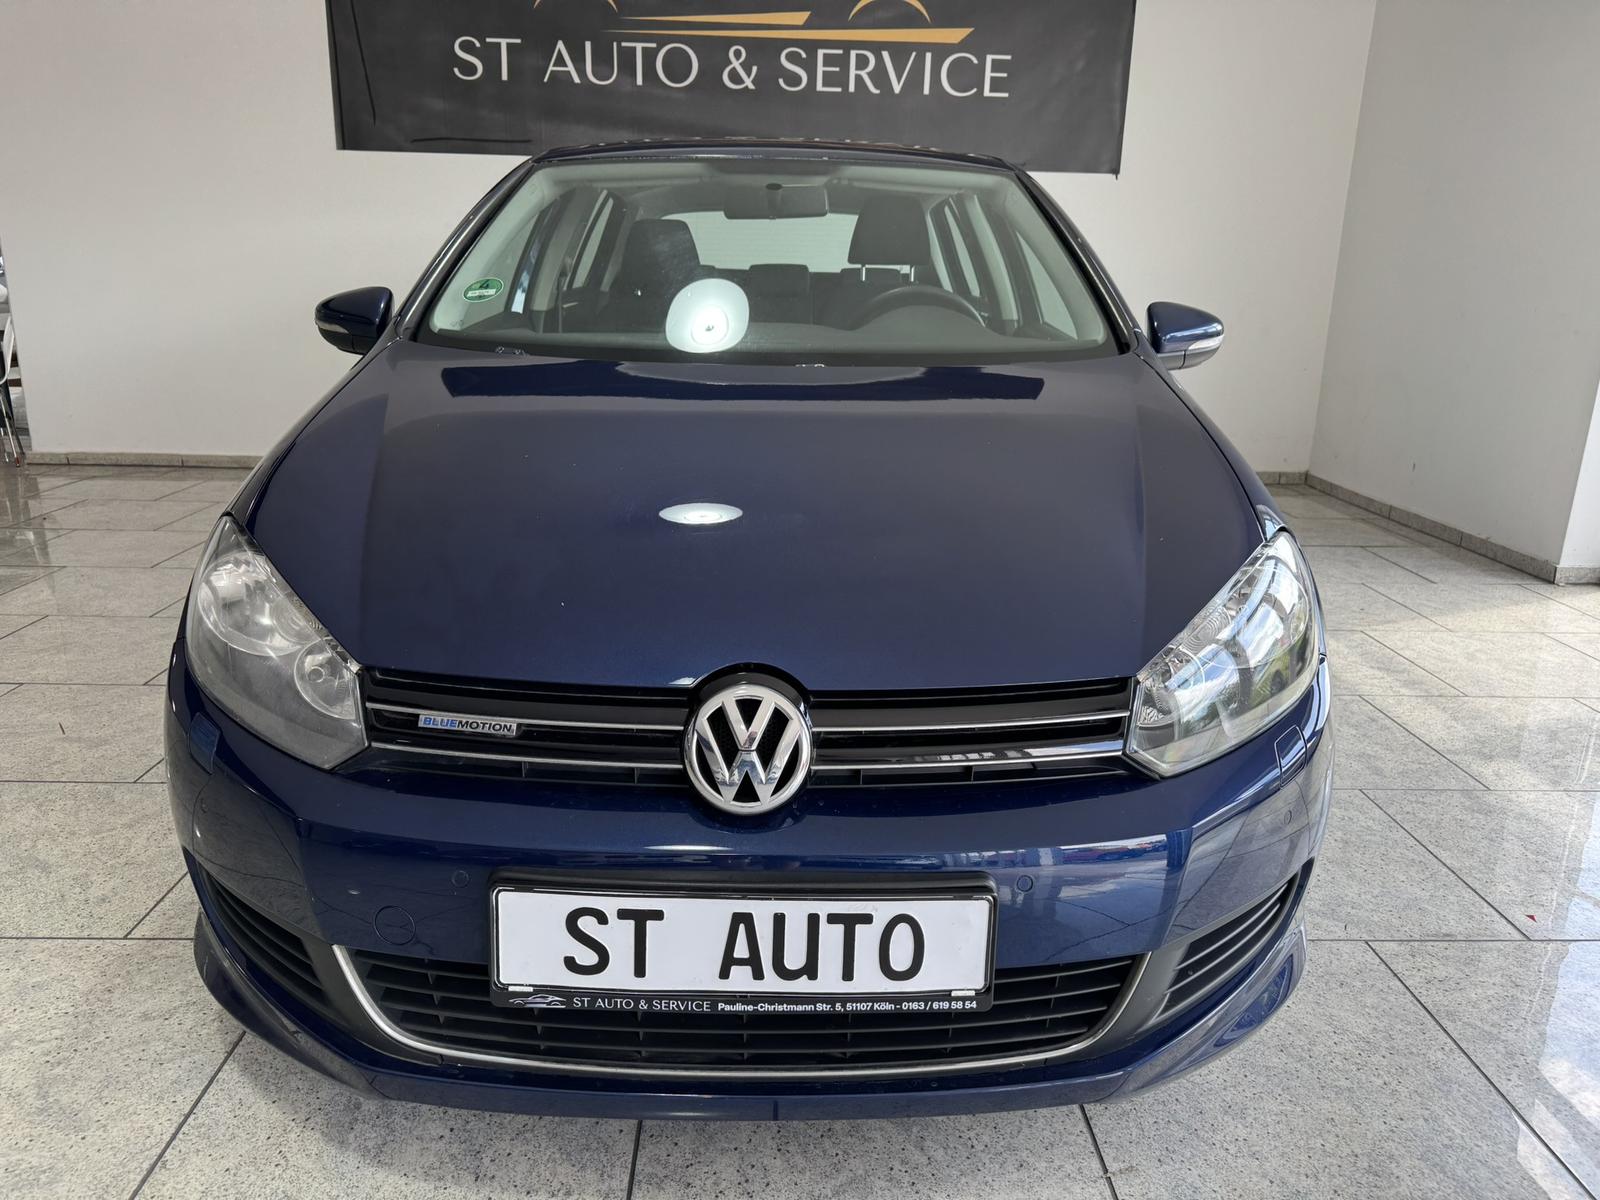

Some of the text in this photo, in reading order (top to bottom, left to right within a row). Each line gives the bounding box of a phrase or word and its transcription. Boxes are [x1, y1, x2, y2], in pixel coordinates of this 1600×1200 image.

[453, 36, 1012, 98] ST AUTO & SERVICE
[422, 716, 513, 732] BLUEMOTION
[563, 906, 925, 982] ST AUTO
[573, 996, 591, 1008] ST
[594, 997, 634, 1010] AUTO
[638, 999, 649, 1010] &
[652, 999, 711, 1012] SERVICE
[717, 1002, 815, 1013] Pauline-Christmann
[815, 1002, 833, 1012] Str.
[835, 1002, 845, 1014] 5,
[846, 1002, 873, 1012] 51107
[873, 1001, 895, 1011] Köln
[902, 1001, 925, 1011] 0163
[932, 1000, 950, 1010] 619
[950, 1000, 964, 1010] 58
[964, 1000, 977, 1009] 54
